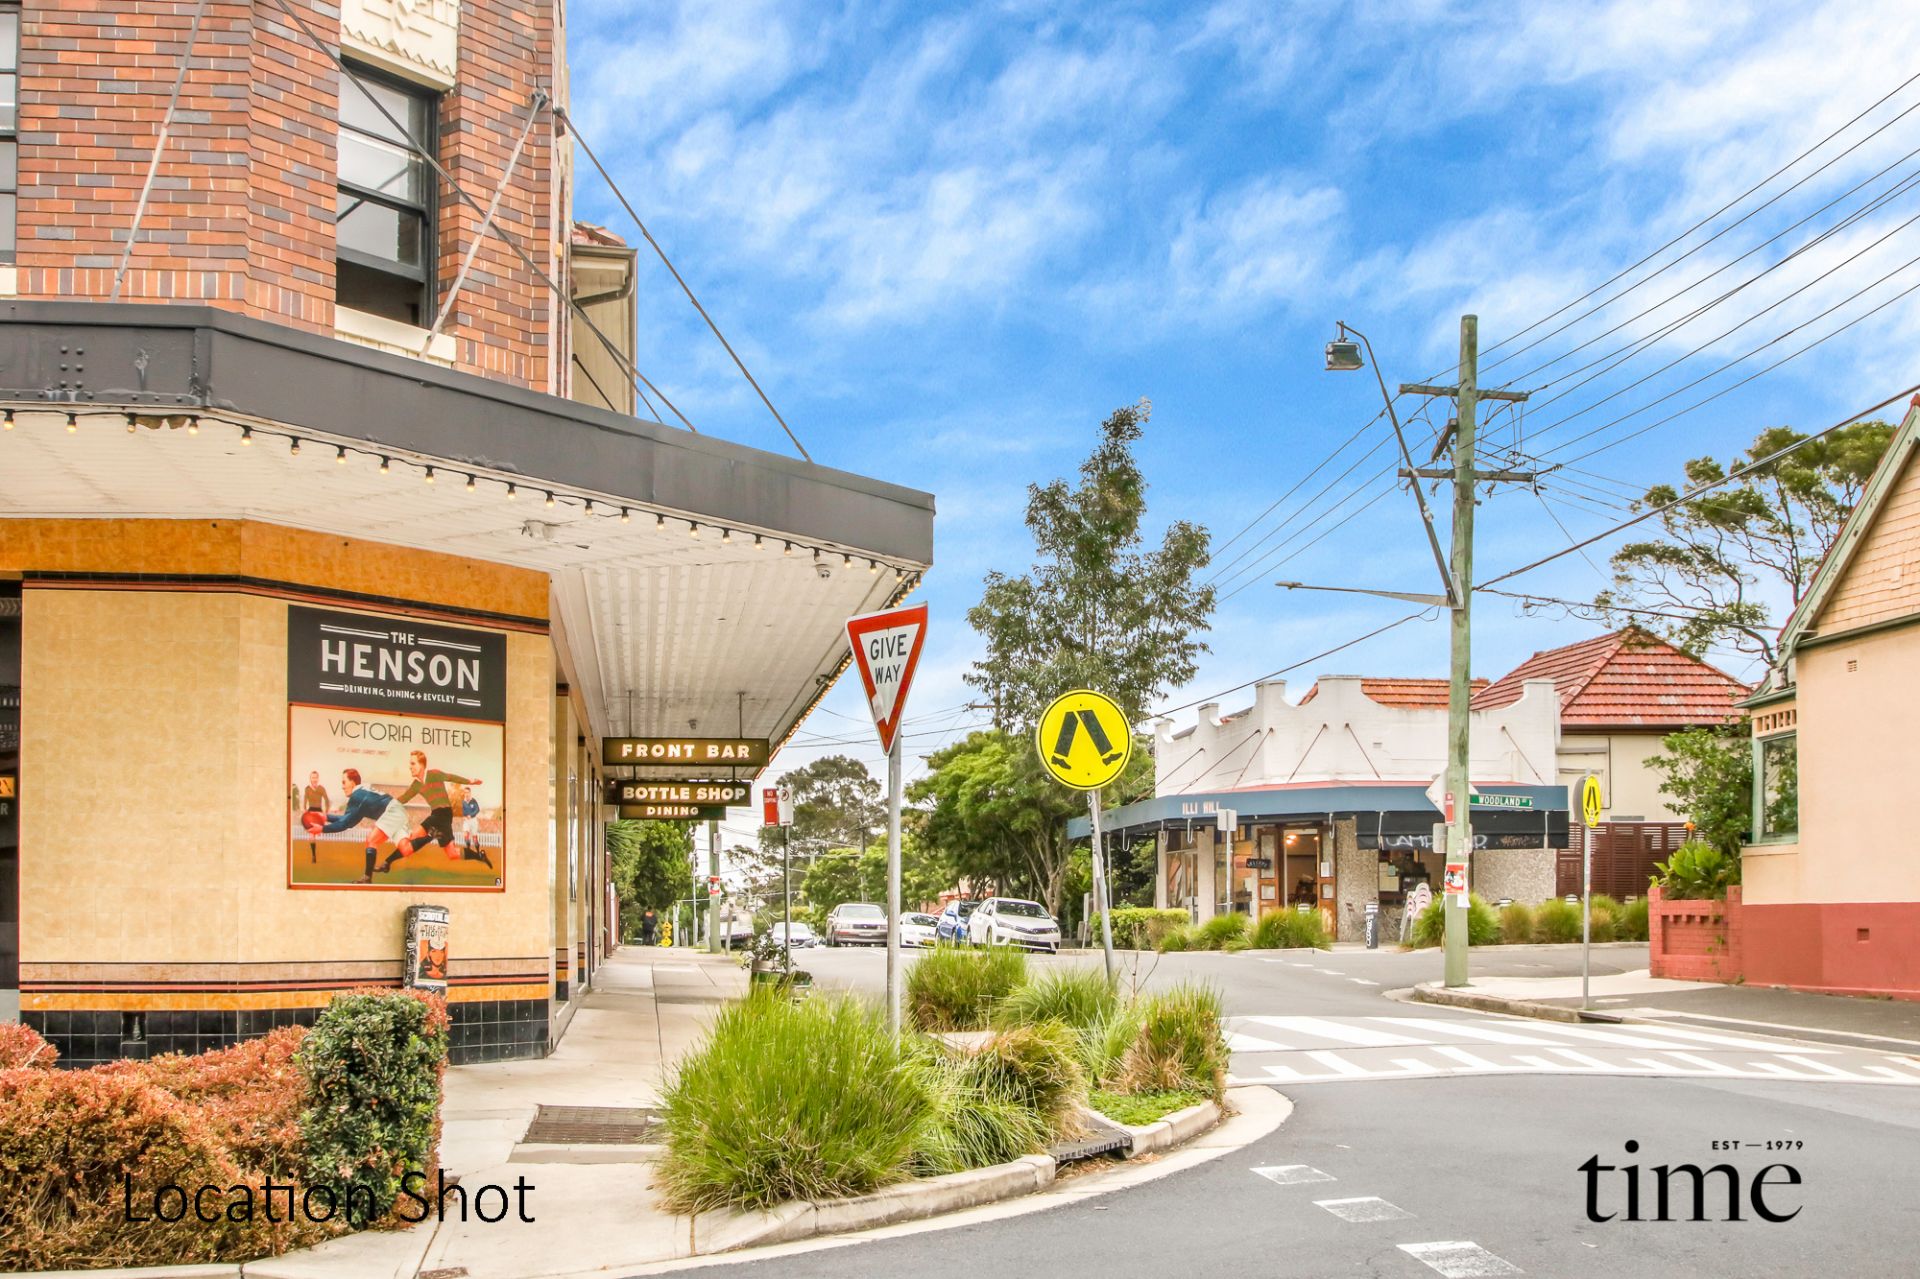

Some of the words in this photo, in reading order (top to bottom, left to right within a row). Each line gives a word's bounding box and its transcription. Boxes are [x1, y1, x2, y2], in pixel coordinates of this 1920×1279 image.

[390, 632, 415, 646] THE
[870, 633, 907, 661] GIVE
[321, 639, 480, 691] HENSON
[875, 663, 901, 685] WAY
[387, 689, 417, 699] DINING
[423, 692, 455, 704] REVELRY
[328, 718, 412, 743] VICTORIA
[421, 727, 472, 748] BITTER
[621, 743, 695, 758] FRONT
[706, 744, 750, 759] BAR
[622, 786, 690, 801] BOTTLE
[696, 787, 746, 801] SHOP
[1479, 795, 1520, 806] WOODLAND
[646, 806, 699, 816] DINING
